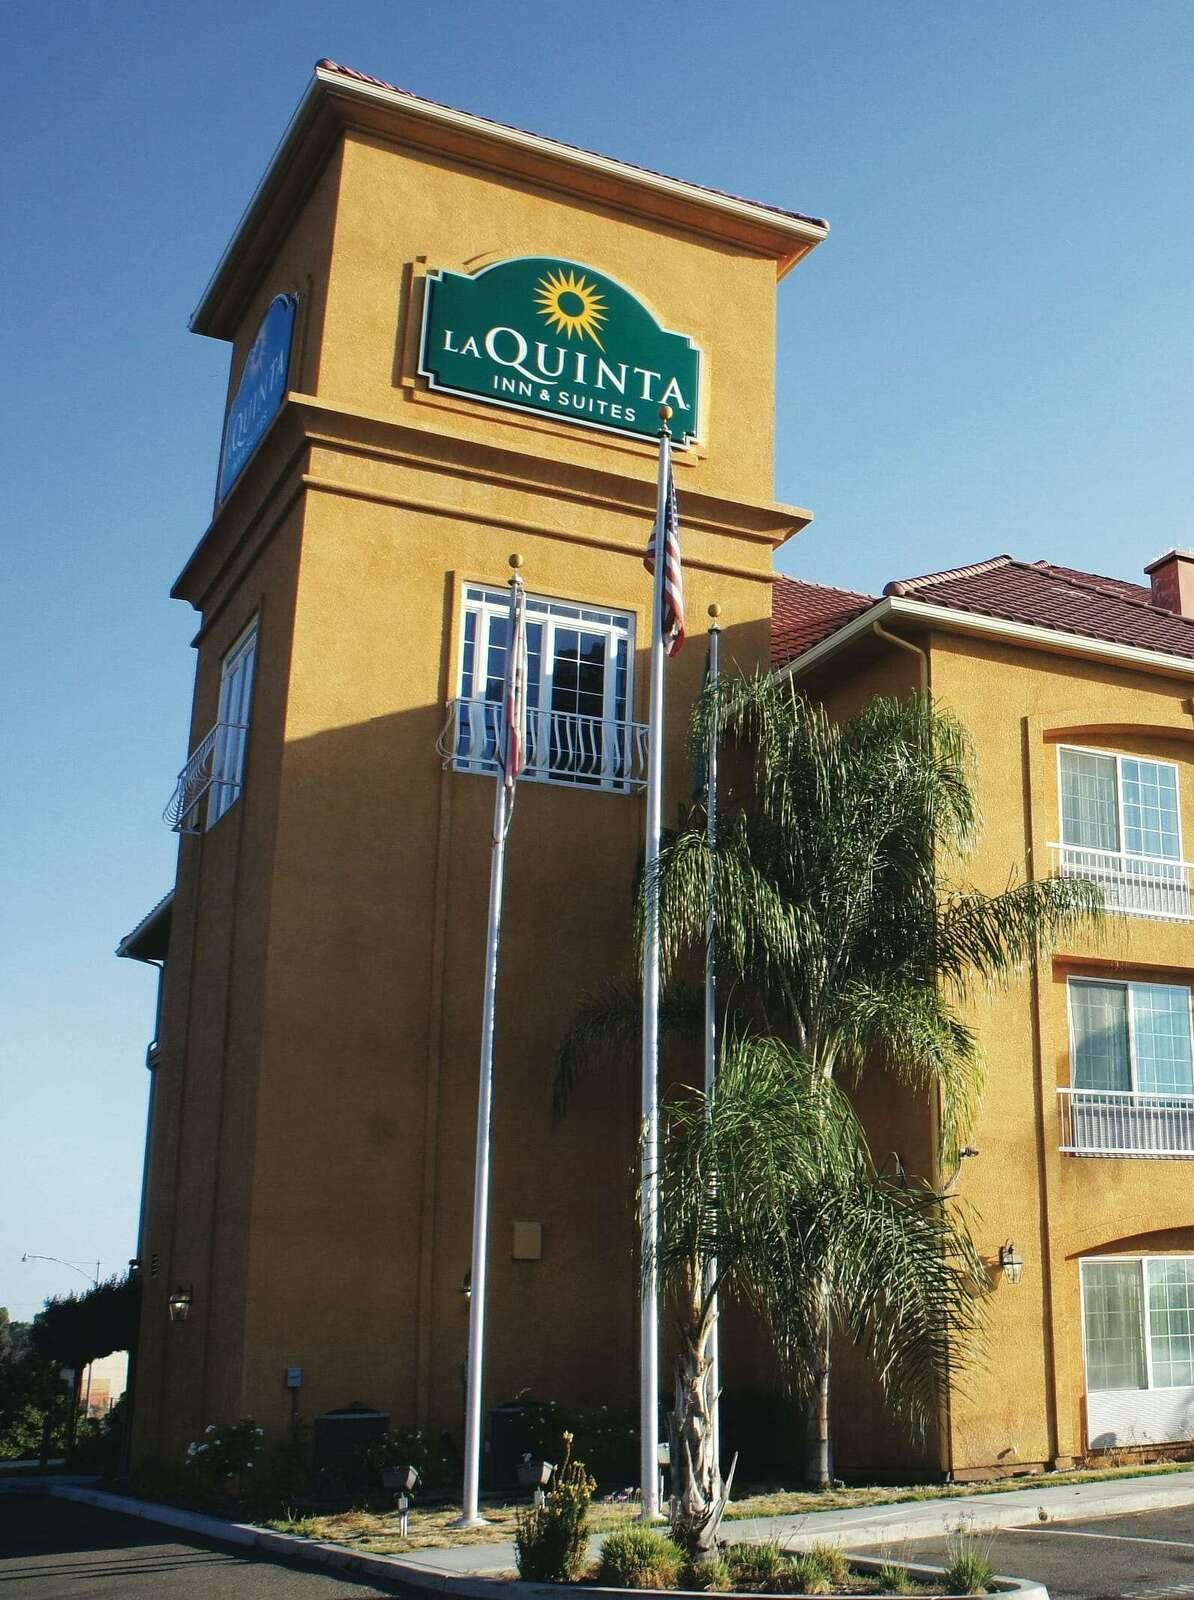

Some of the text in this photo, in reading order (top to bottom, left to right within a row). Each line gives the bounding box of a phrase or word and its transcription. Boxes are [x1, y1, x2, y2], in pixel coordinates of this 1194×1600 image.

[444, 327, 688, 411] LA QUINTA
[493, 375, 636, 422] INN & SUITES
